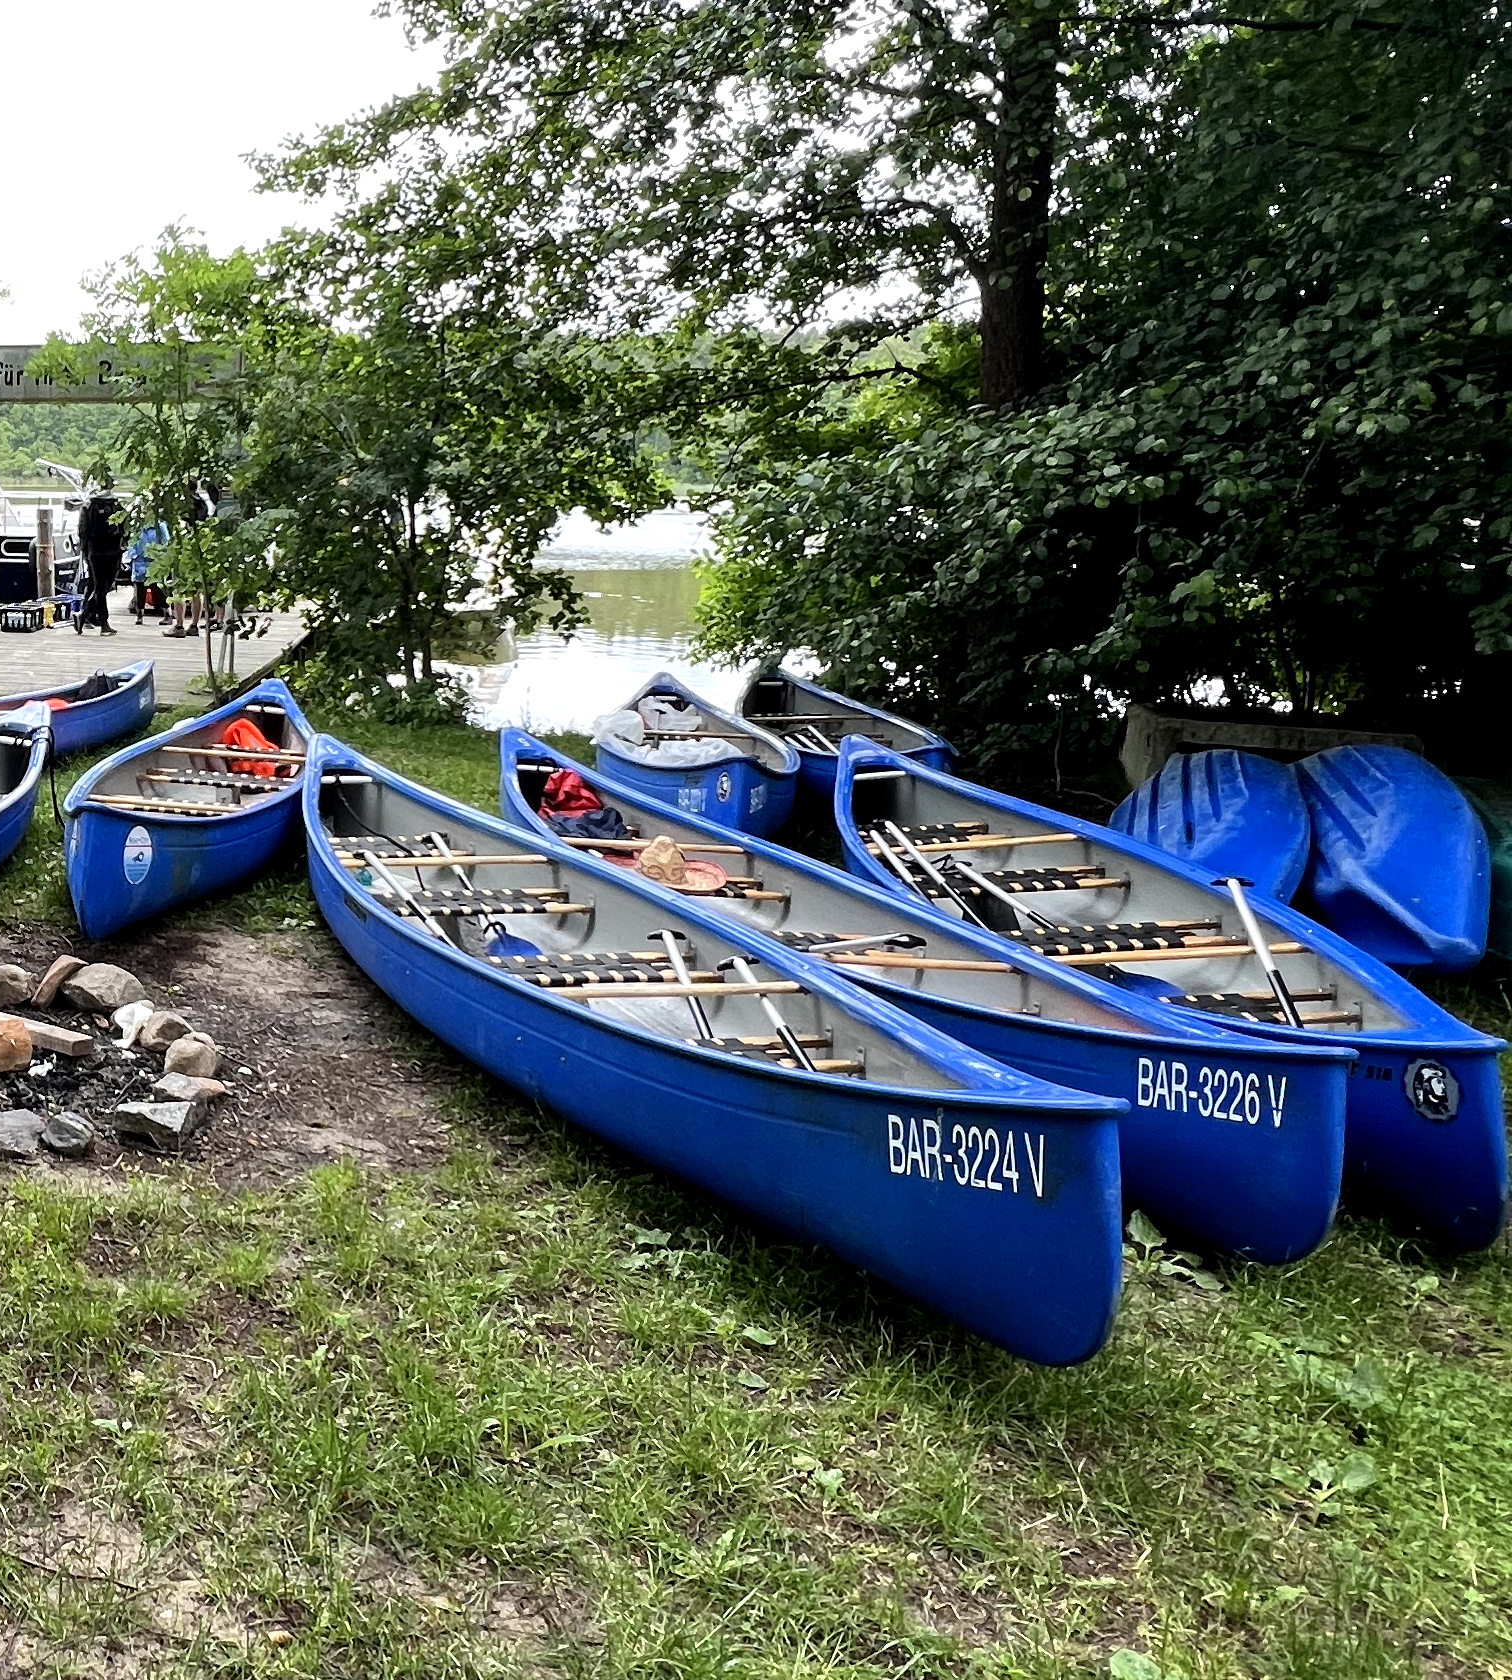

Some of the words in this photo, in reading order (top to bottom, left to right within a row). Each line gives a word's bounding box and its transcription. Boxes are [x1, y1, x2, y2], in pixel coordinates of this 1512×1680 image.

[1137, 1057, 1260, 1125] BAR-3226
[1267, 1074, 1287, 1129] V
[887, 1114, 1020, 1194] BAR-3224
[1024, 1131, 1045, 1198] V
